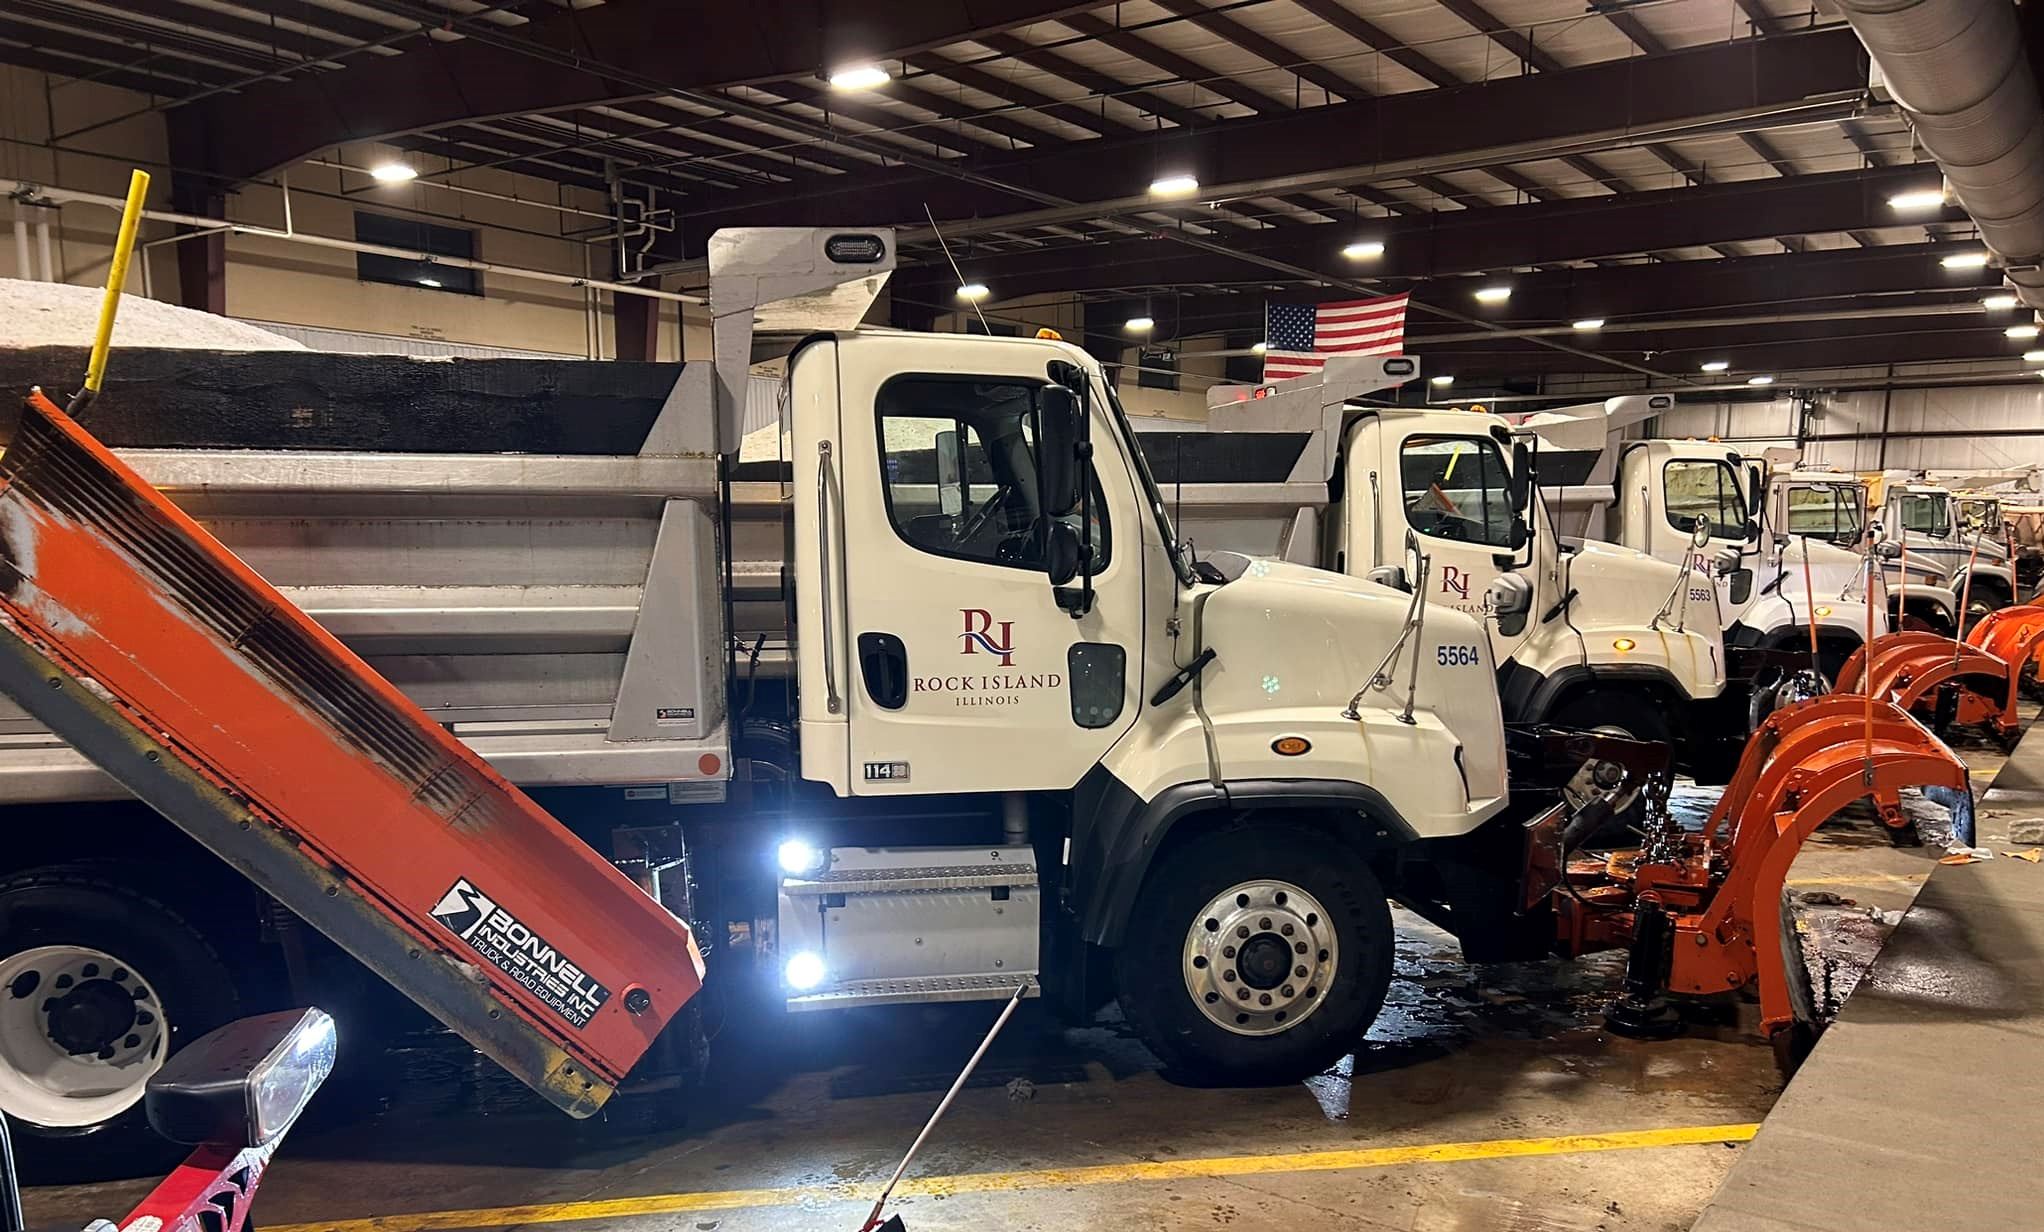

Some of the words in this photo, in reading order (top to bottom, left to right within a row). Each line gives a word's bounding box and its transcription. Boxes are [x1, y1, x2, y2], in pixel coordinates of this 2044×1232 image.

[1440, 566, 1471, 600] RI
[1689, 588, 1711, 601] 5563
[958, 608, 1016, 667] RI
[1437, 645, 1479, 665] 5564
[914, 676, 974, 692] ROCK
[981, 674, 1062, 690] ISLAND
[955, 695, 1020, 706] ILLINOIS
[866, 764, 891, 778] 114
[477, 924, 570, 998] INDUSTRIES
[566, 992, 595, 1018] INC
[487, 908, 601, 1007] BONNELL
[470, 935, 504, 964] TRUCK
[500, 960, 510, 971] &
[508, 966, 537, 990] ROAD
[533, 984, 587, 1027] EQUIPMENT
